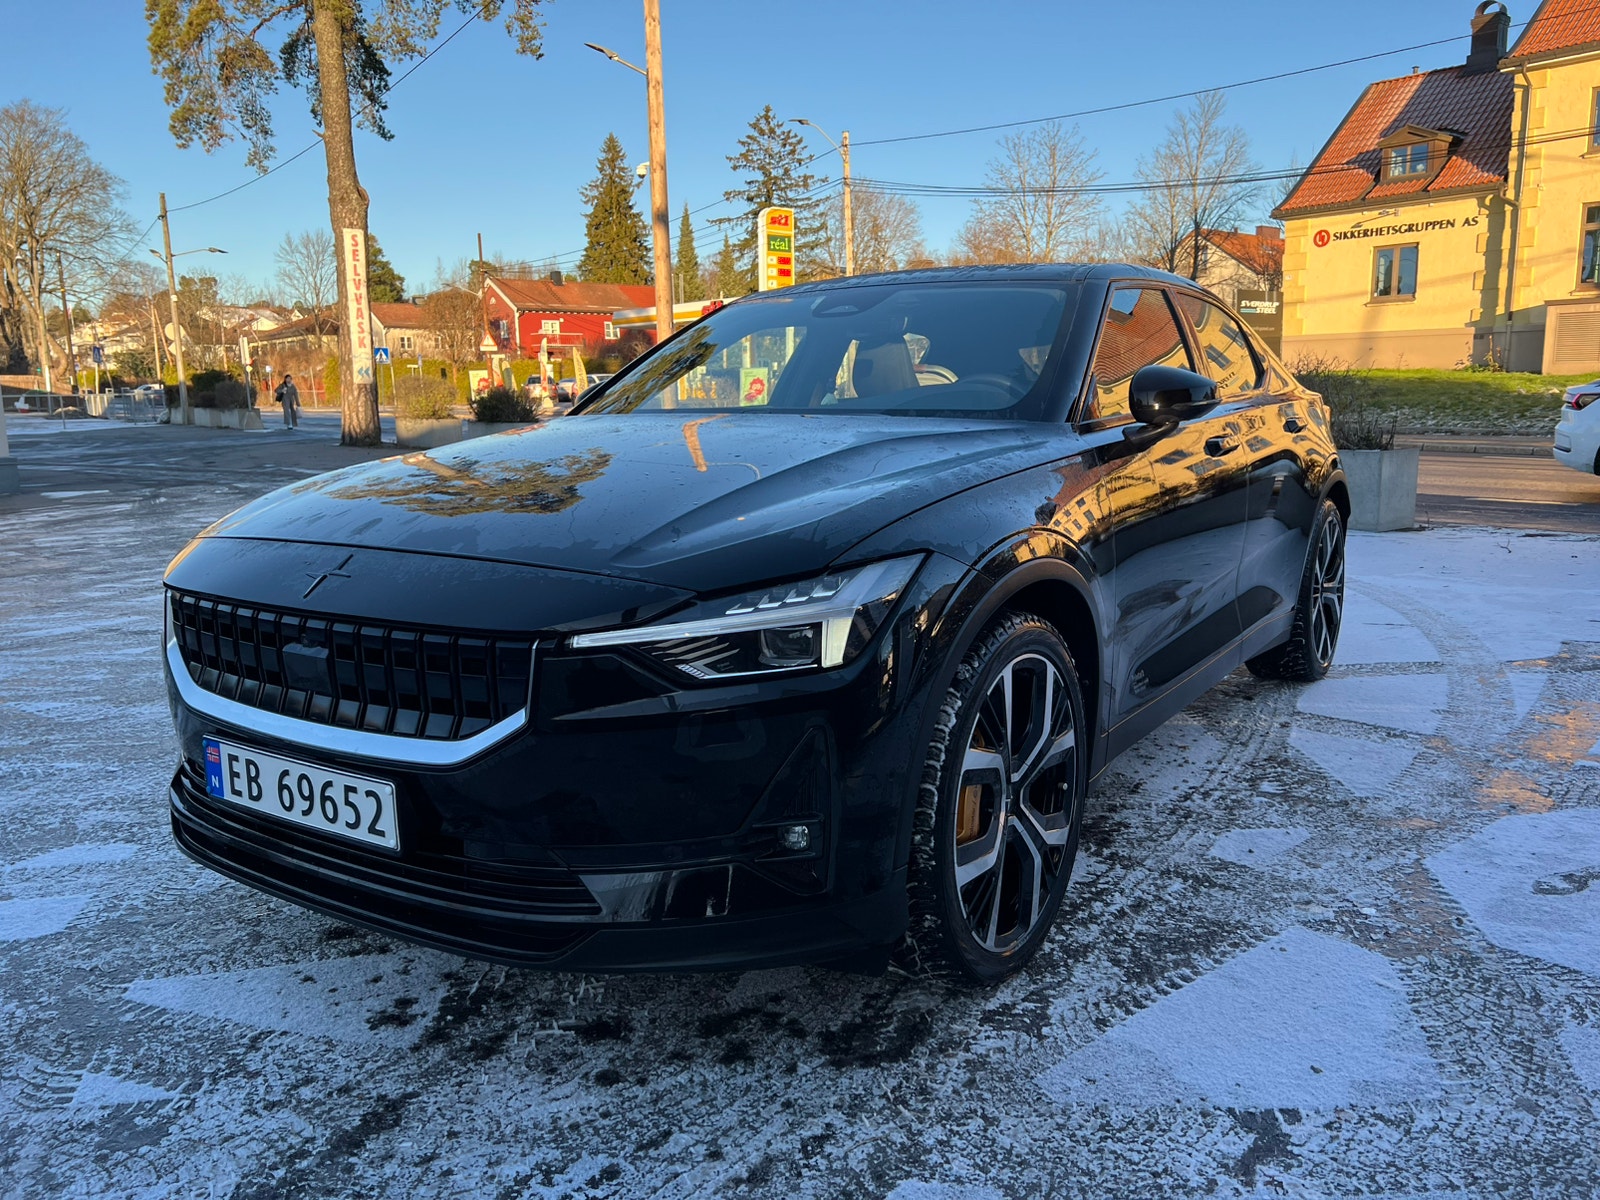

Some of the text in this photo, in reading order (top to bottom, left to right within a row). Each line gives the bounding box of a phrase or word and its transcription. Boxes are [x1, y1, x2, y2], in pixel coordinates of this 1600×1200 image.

[1332, 215, 1479, 241] SIKKERHETSGRUPPEN AS
[770, 237, 789, 250] réal
[351, 234, 367, 348] SELVVASK
[1240, 300, 1280, 308] SVERDRUP
[211, 775, 219, 788] N
[227, 753, 386, 838] EB 69652
